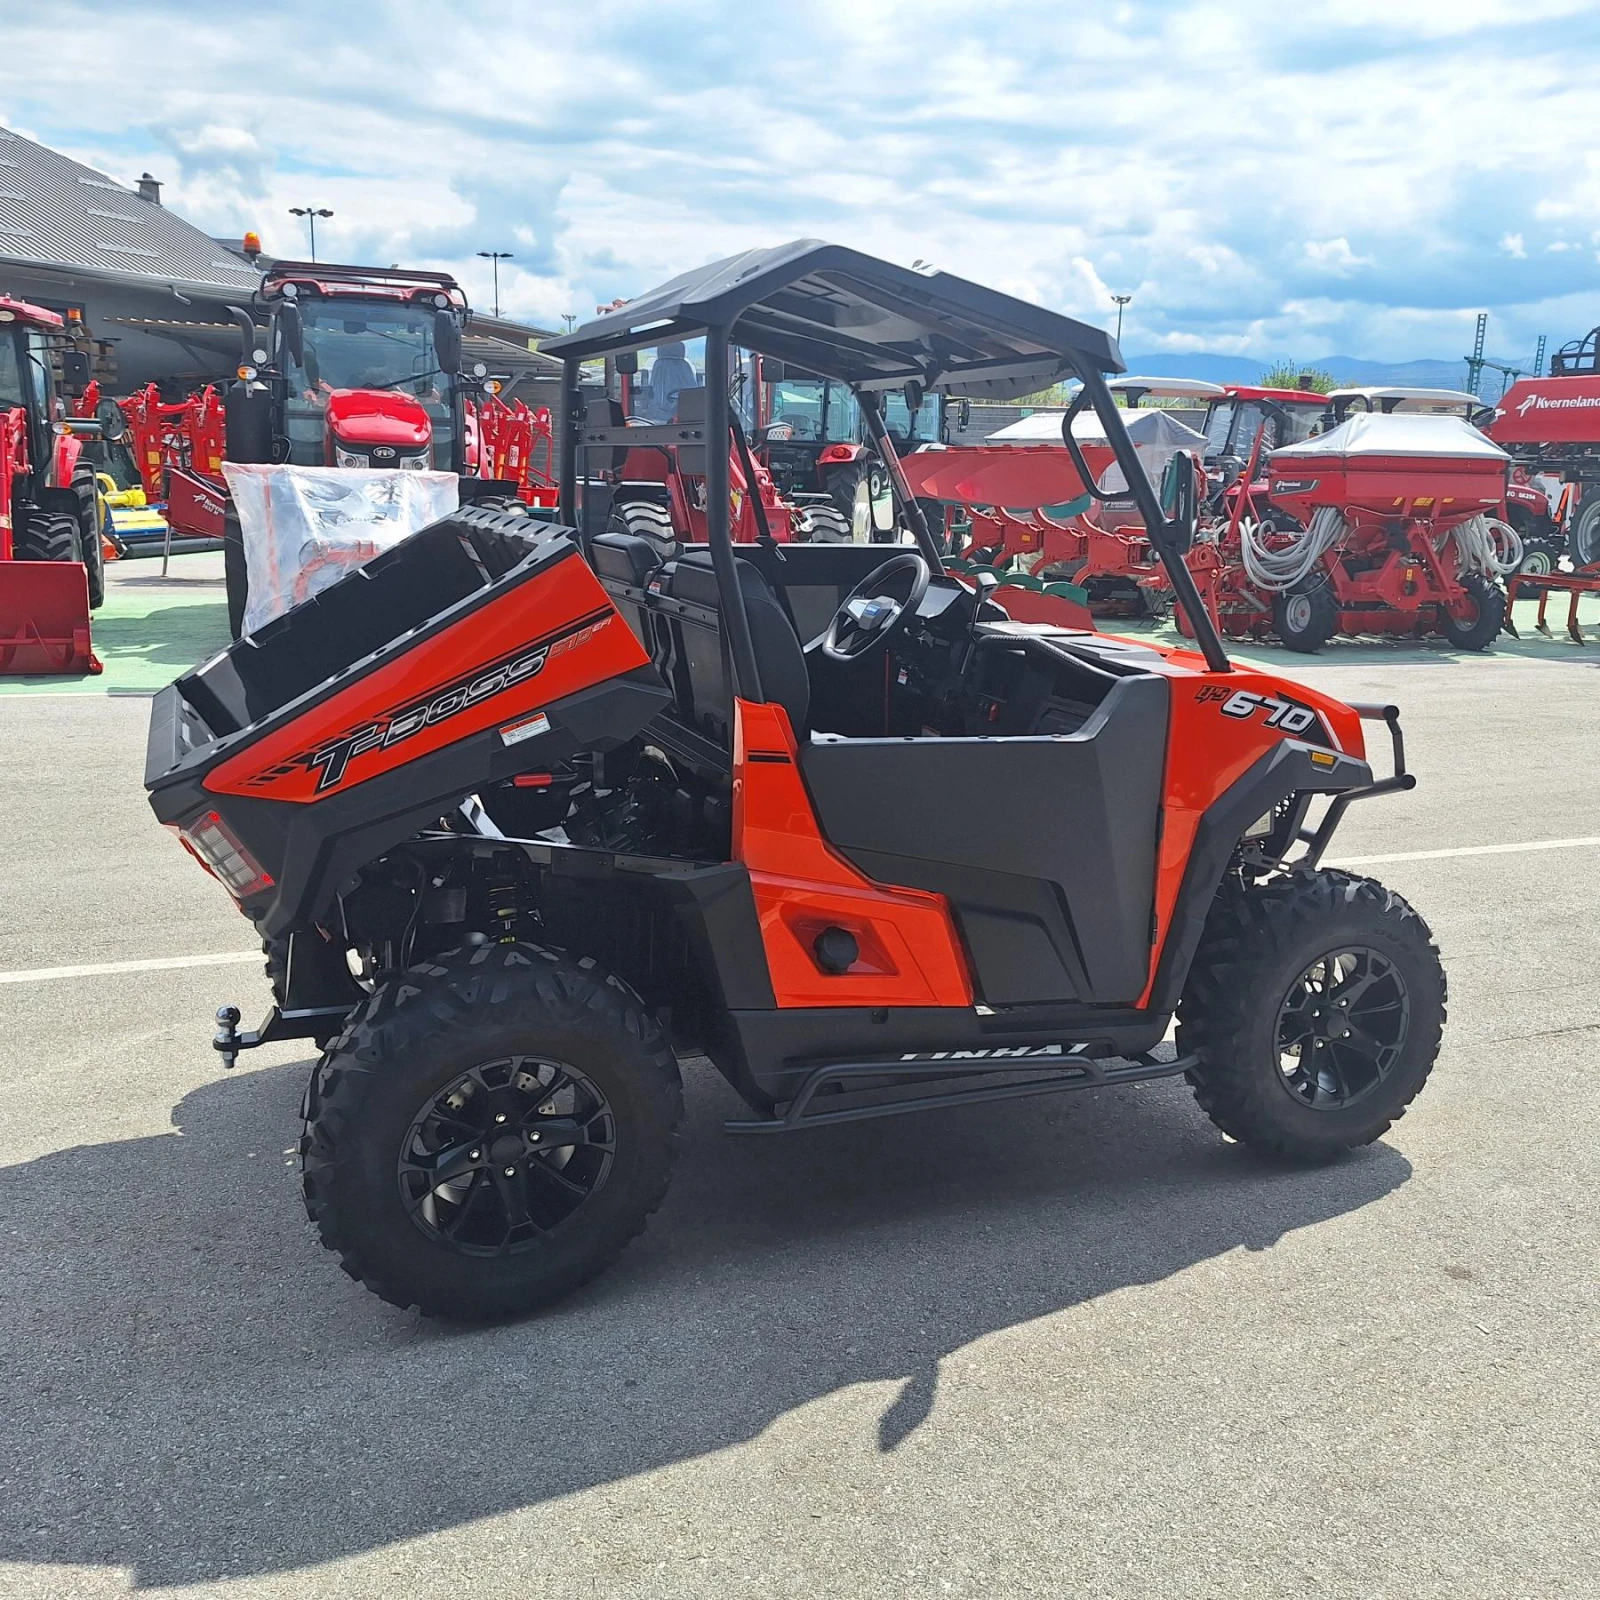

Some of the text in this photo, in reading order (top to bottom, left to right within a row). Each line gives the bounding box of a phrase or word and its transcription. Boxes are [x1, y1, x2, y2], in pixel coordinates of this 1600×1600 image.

[309, 644, 549, 793] T-BOSS
[592, 617, 613, 632] EFI
[1220, 689, 1318, 736] 670
